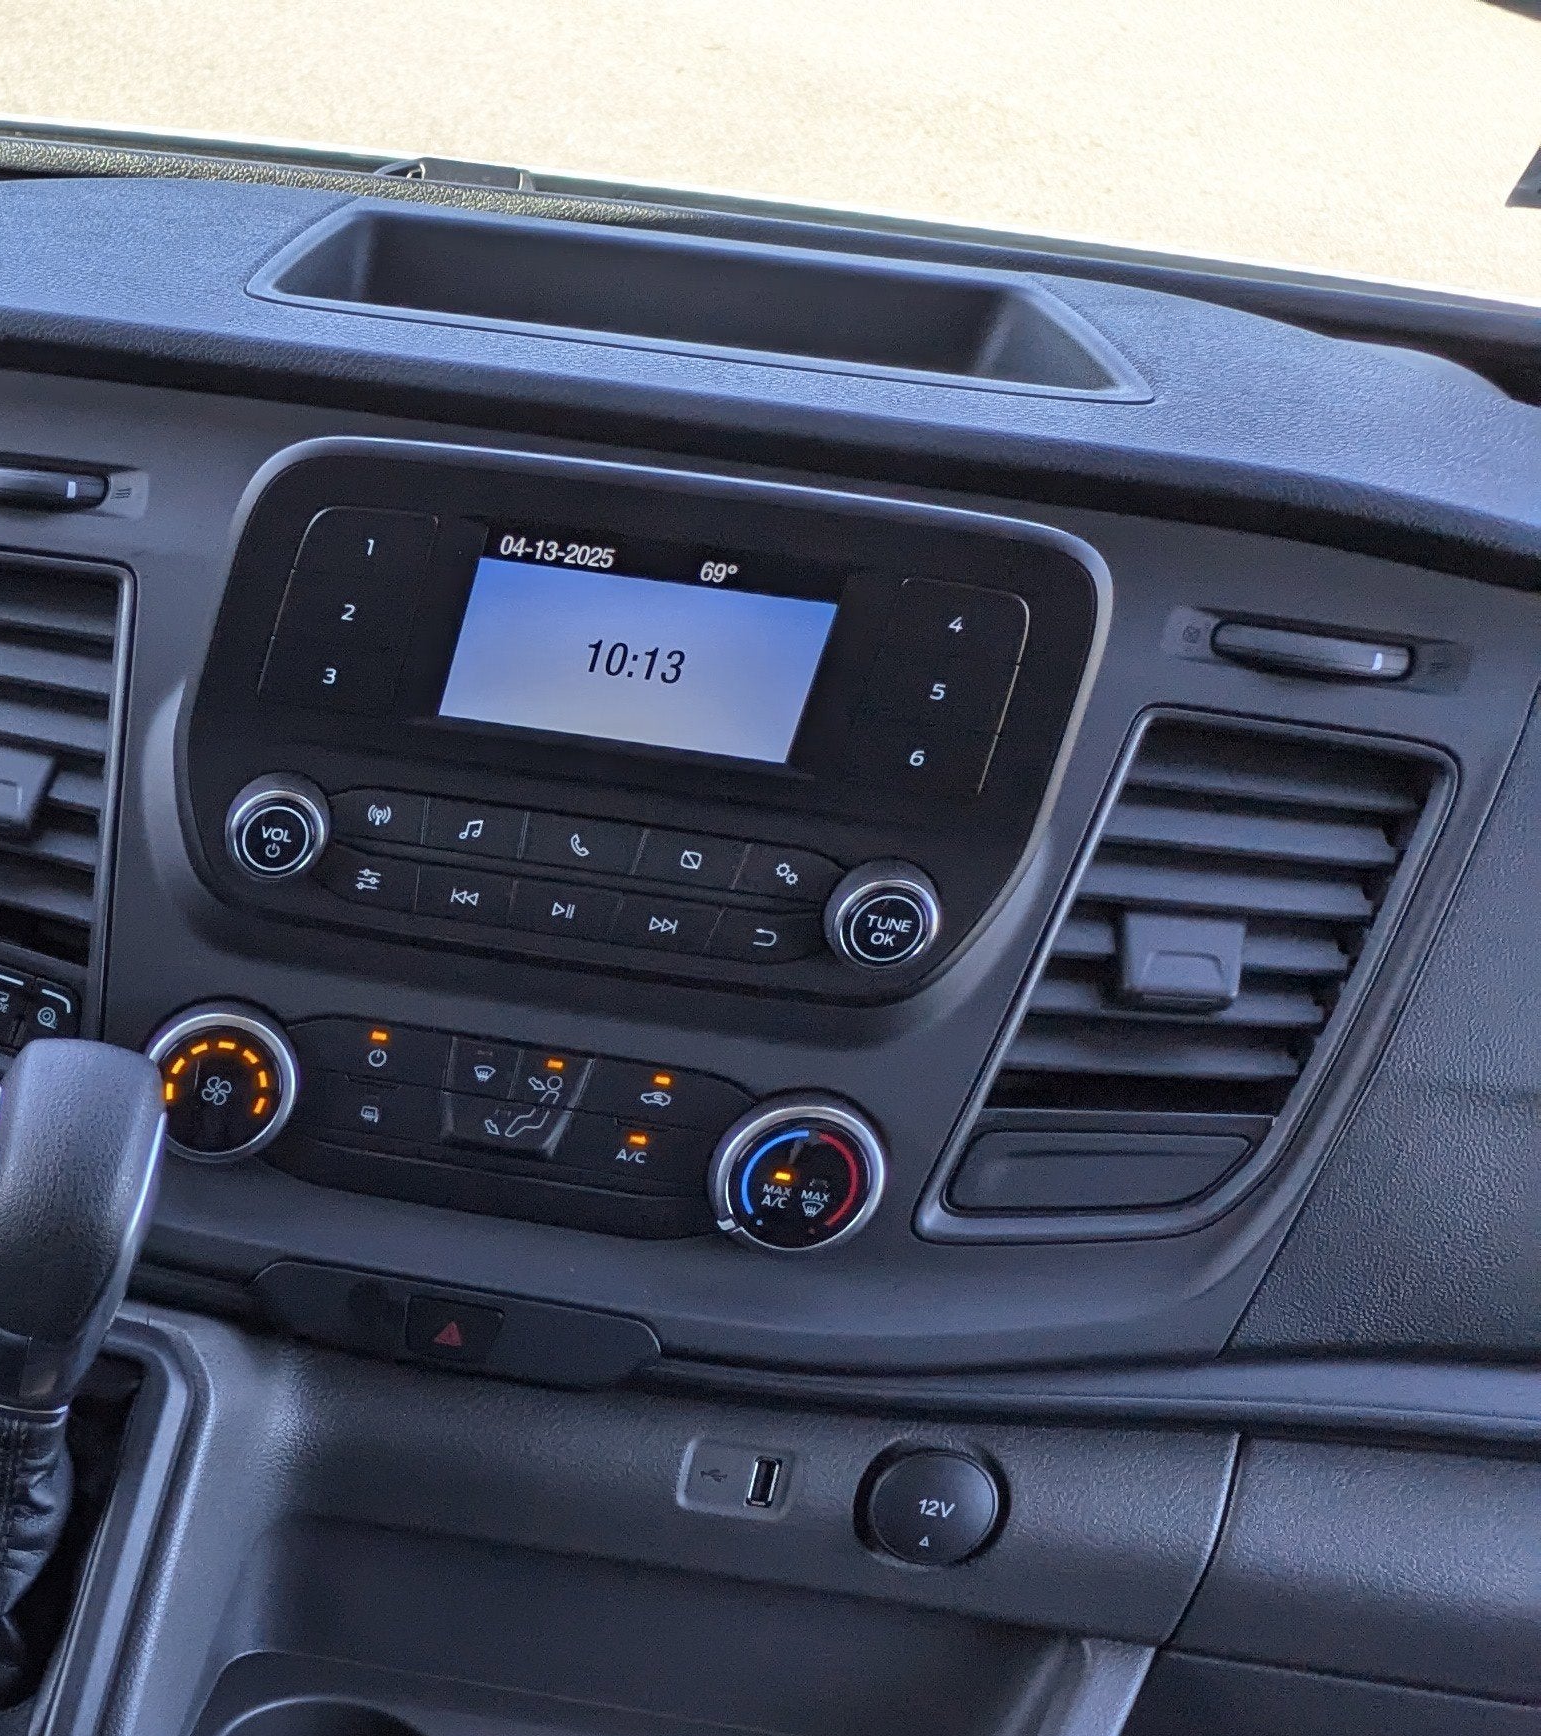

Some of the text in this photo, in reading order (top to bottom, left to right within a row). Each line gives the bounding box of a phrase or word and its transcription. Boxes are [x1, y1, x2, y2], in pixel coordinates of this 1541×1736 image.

[367, 538, 375, 556] 1
[500, 535, 616, 569] 04-13-2025
[340, 604, 356, 621] 2
[948, 616, 963, 633] 4
[588, 639, 686, 684] 10:13
[322, 667, 337, 684] 3
[929, 683, 947, 701] 5
[909, 750, 925, 767] 6
[262, 825, 292, 843] VOL
[867, 914, 912, 933] TUNE
[870, 932, 895, 947] OK
[615, 1148, 648, 1164] A/C
[762, 1183, 792, 1197] MAX
[800, 1190, 830, 1203] MAX
[761, 1195, 788, 1209] A/C
[918, 1499, 955, 1518] 12V
